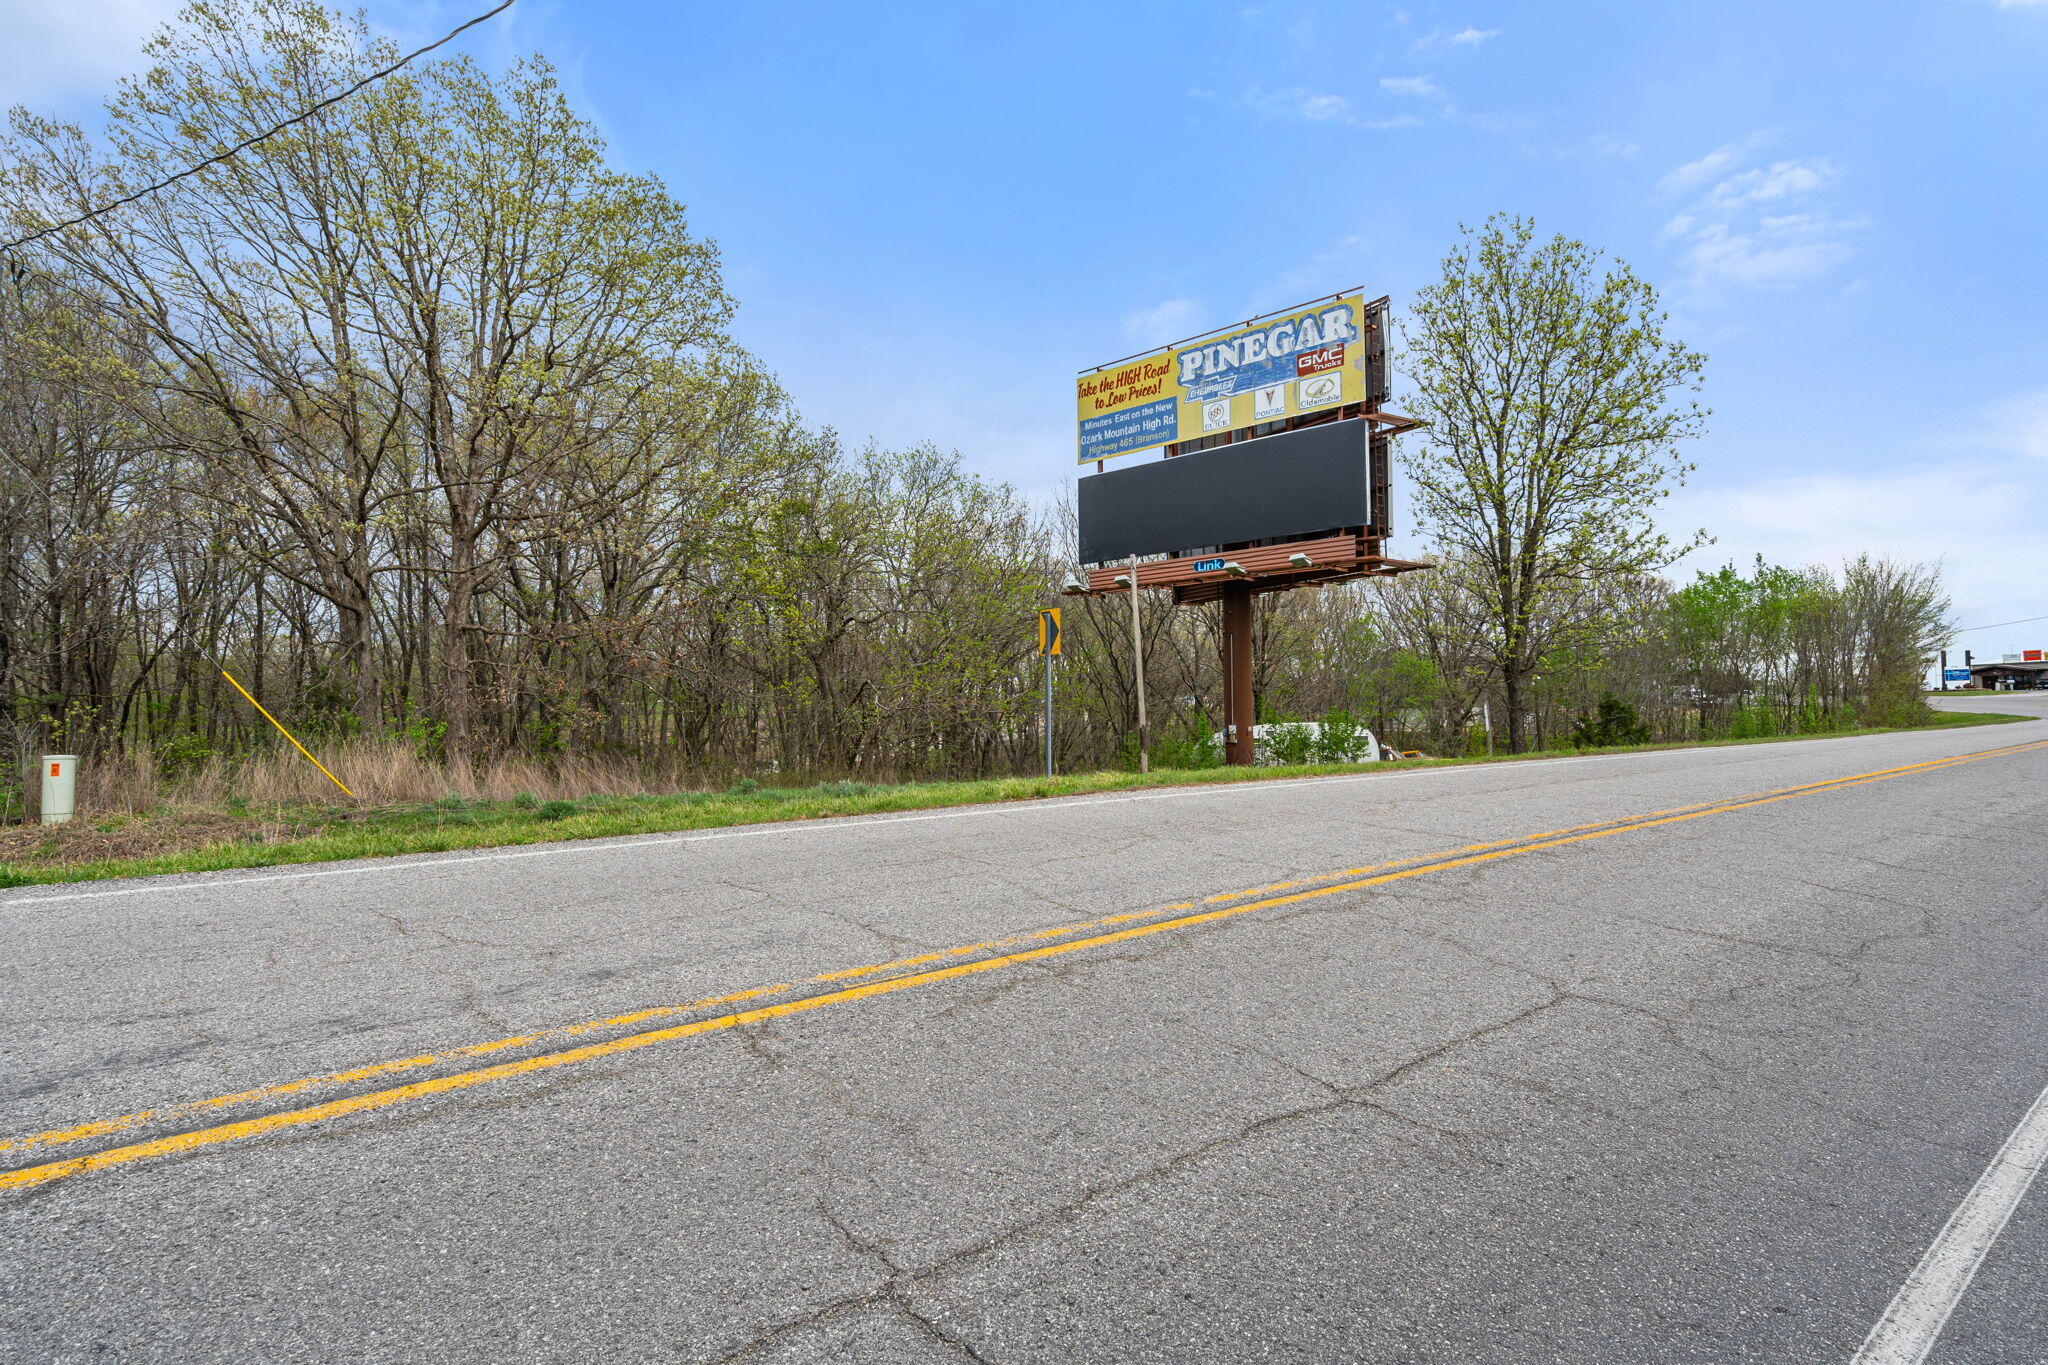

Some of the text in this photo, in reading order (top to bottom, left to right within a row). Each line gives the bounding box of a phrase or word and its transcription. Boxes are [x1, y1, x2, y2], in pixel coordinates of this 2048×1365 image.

[1179, 308, 1355, 383] PINEGAR
[1299, 347, 1342, 368] GMC
[1078, 358, 1171, 399] Take the HIGH Road
[1314, 359, 1342, 371] Trucks
[1095, 378, 1162, 409] to Low Prices!
[1300, 393, 1341, 408] Oldsmobile
[1084, 402, 1173, 431] Minutes East on the New
[1255, 406, 1285, 417] PONTIAC
[1081, 414, 1177, 445] Ozark Mountain High Rd.
[1089, 428, 1170, 456] Highway 465 (Branson)
[1197, 559, 1222, 571] Link
